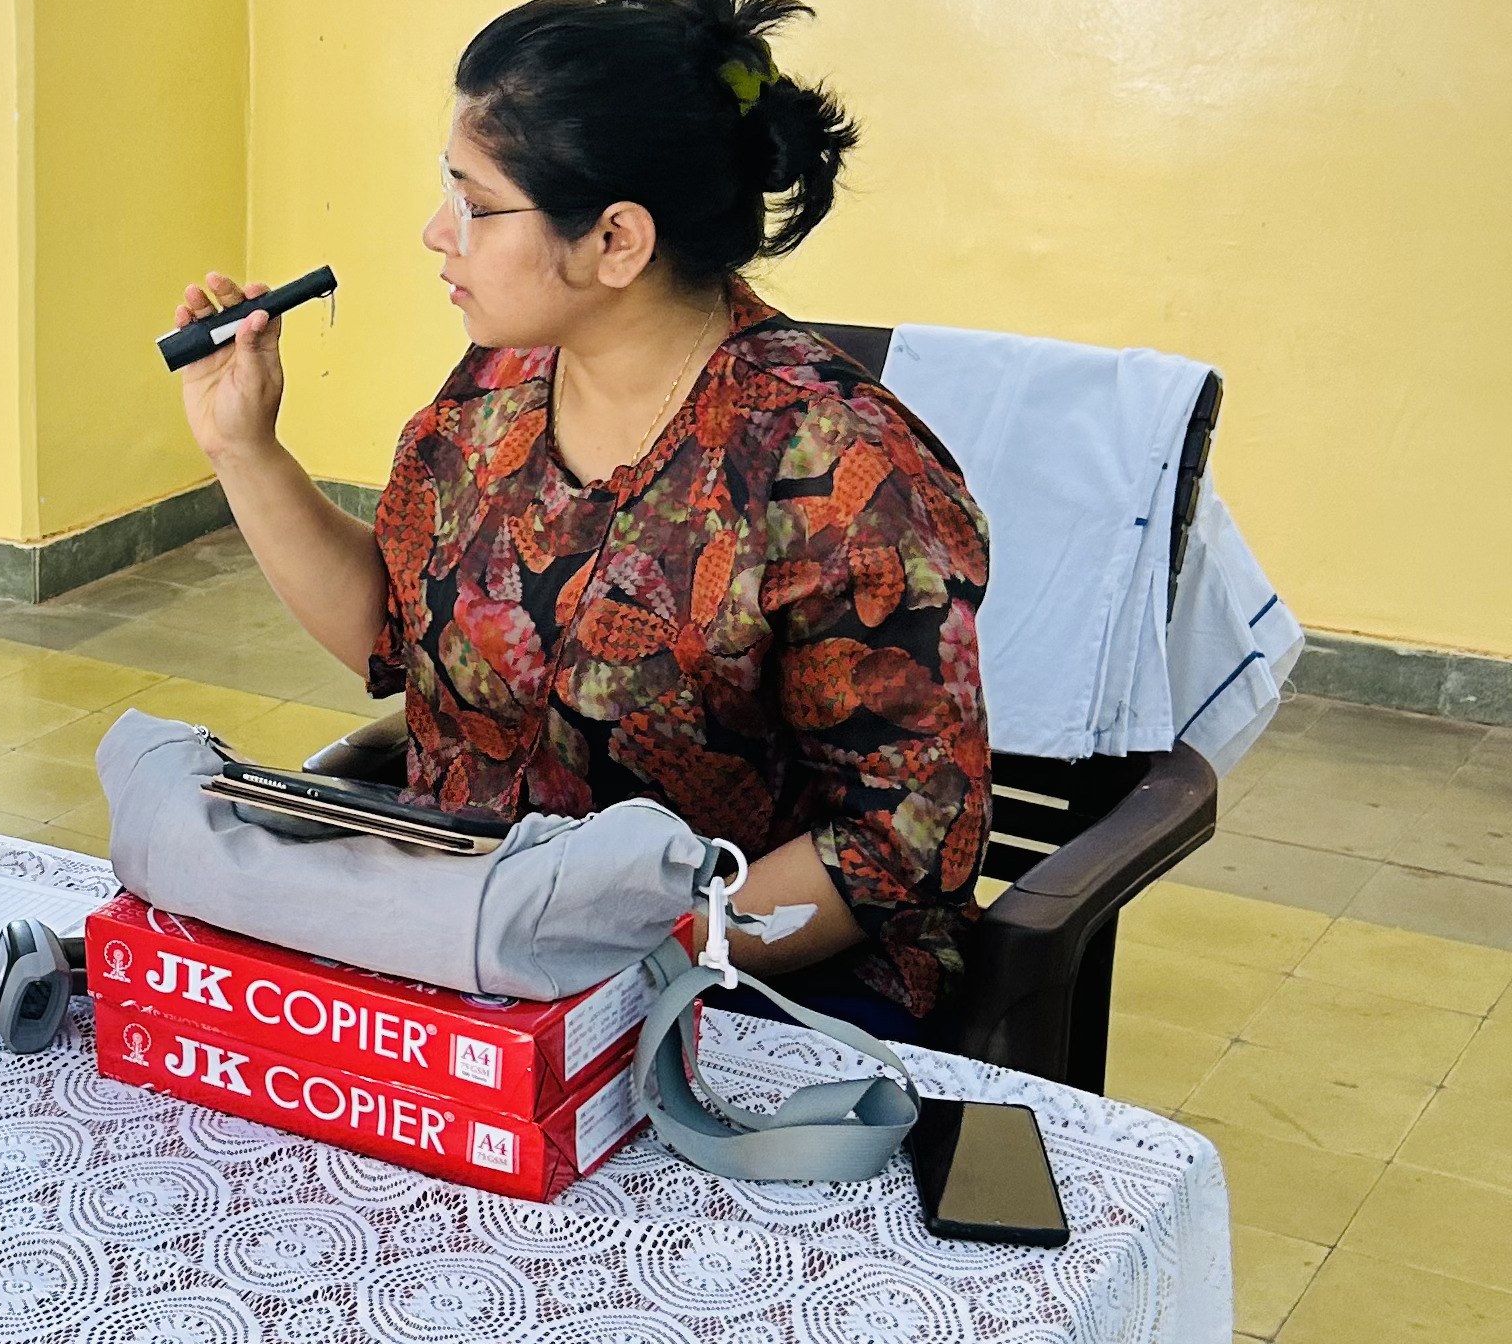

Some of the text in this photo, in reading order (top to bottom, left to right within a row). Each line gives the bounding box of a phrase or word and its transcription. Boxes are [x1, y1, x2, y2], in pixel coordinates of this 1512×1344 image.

[145, 950, 233, 1012] JK
[245, 979, 429, 1068] COPIER
[460, 1043, 491, 1067] A4
[164, 1035, 446, 1155] JK COPIER
[478, 1133, 508, 1156] A4
